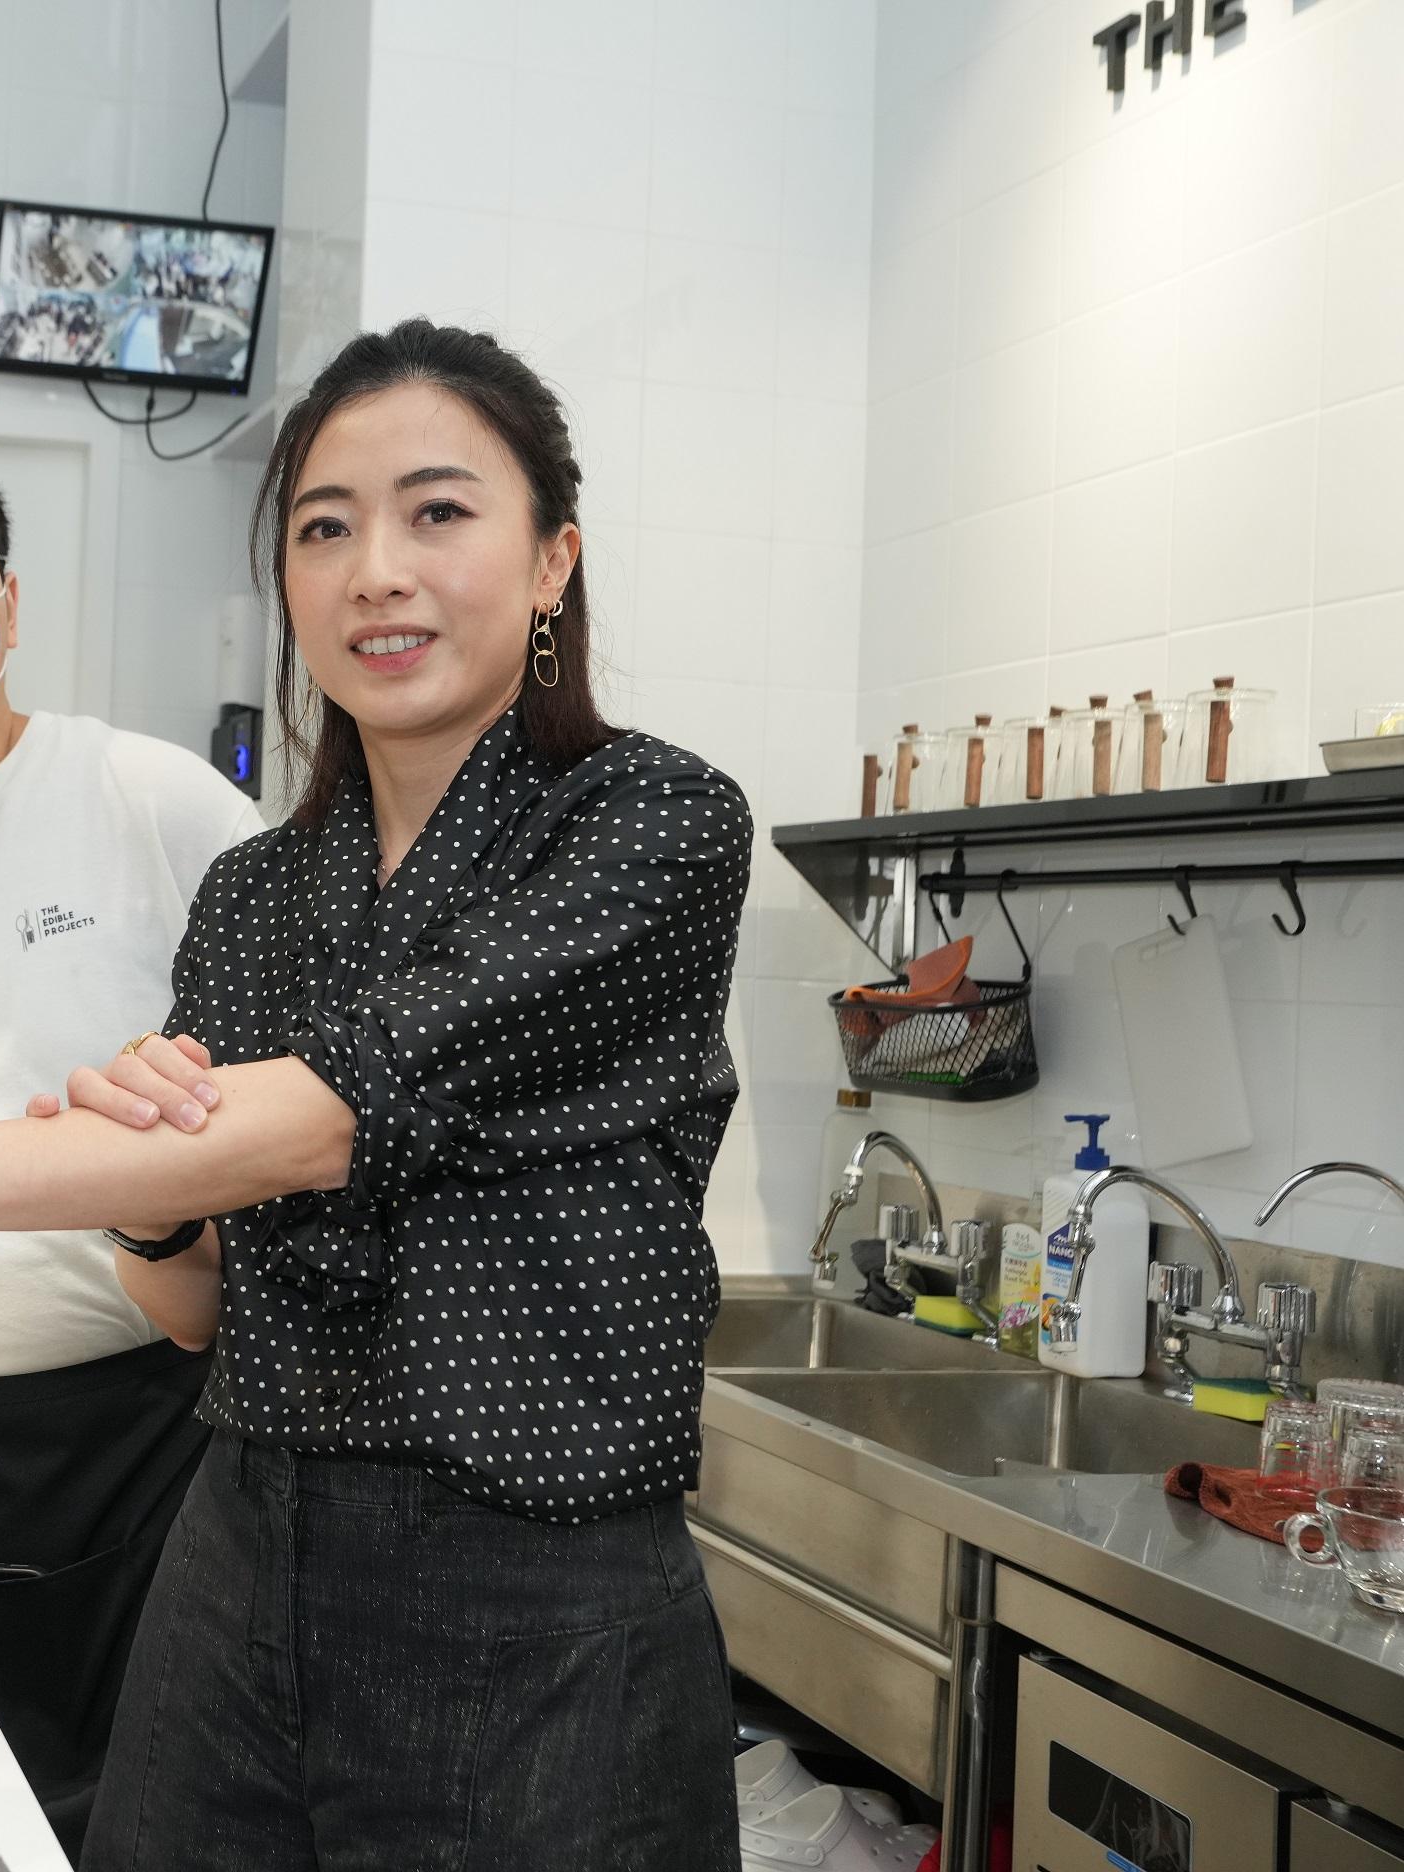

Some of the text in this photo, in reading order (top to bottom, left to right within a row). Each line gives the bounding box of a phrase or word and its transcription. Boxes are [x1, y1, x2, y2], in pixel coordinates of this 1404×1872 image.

[41, 905, 59, 916] THE
[42, 911, 74, 927] EDIBLE
[44, 917, 94, 936] PROJECTS
